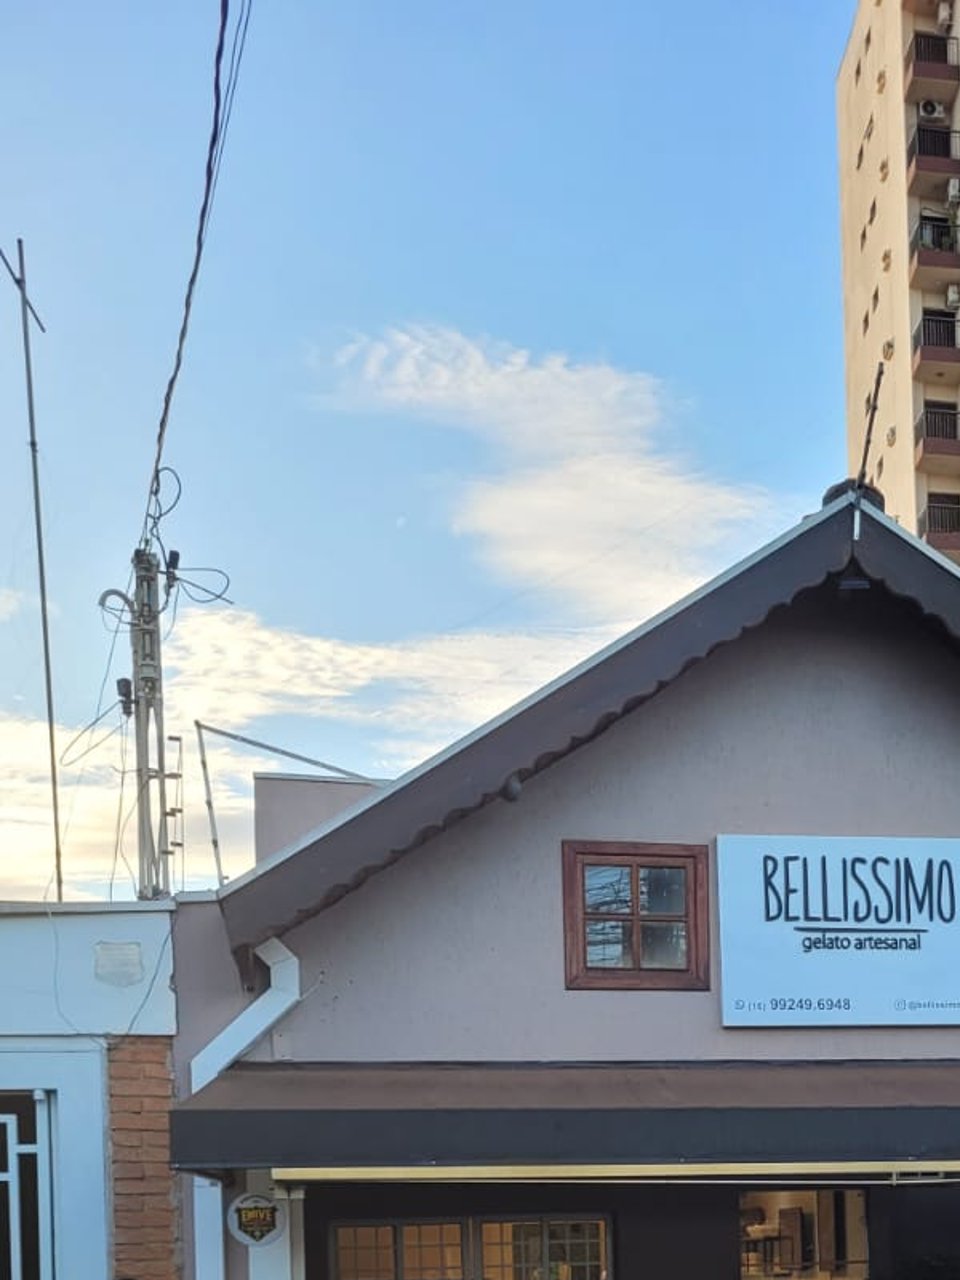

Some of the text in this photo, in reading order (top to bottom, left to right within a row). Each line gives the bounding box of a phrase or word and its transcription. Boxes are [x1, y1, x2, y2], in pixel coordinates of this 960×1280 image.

[762, 855, 956, 924] BELLISSIMO
[802, 933, 921, 952] gelato artesanal
